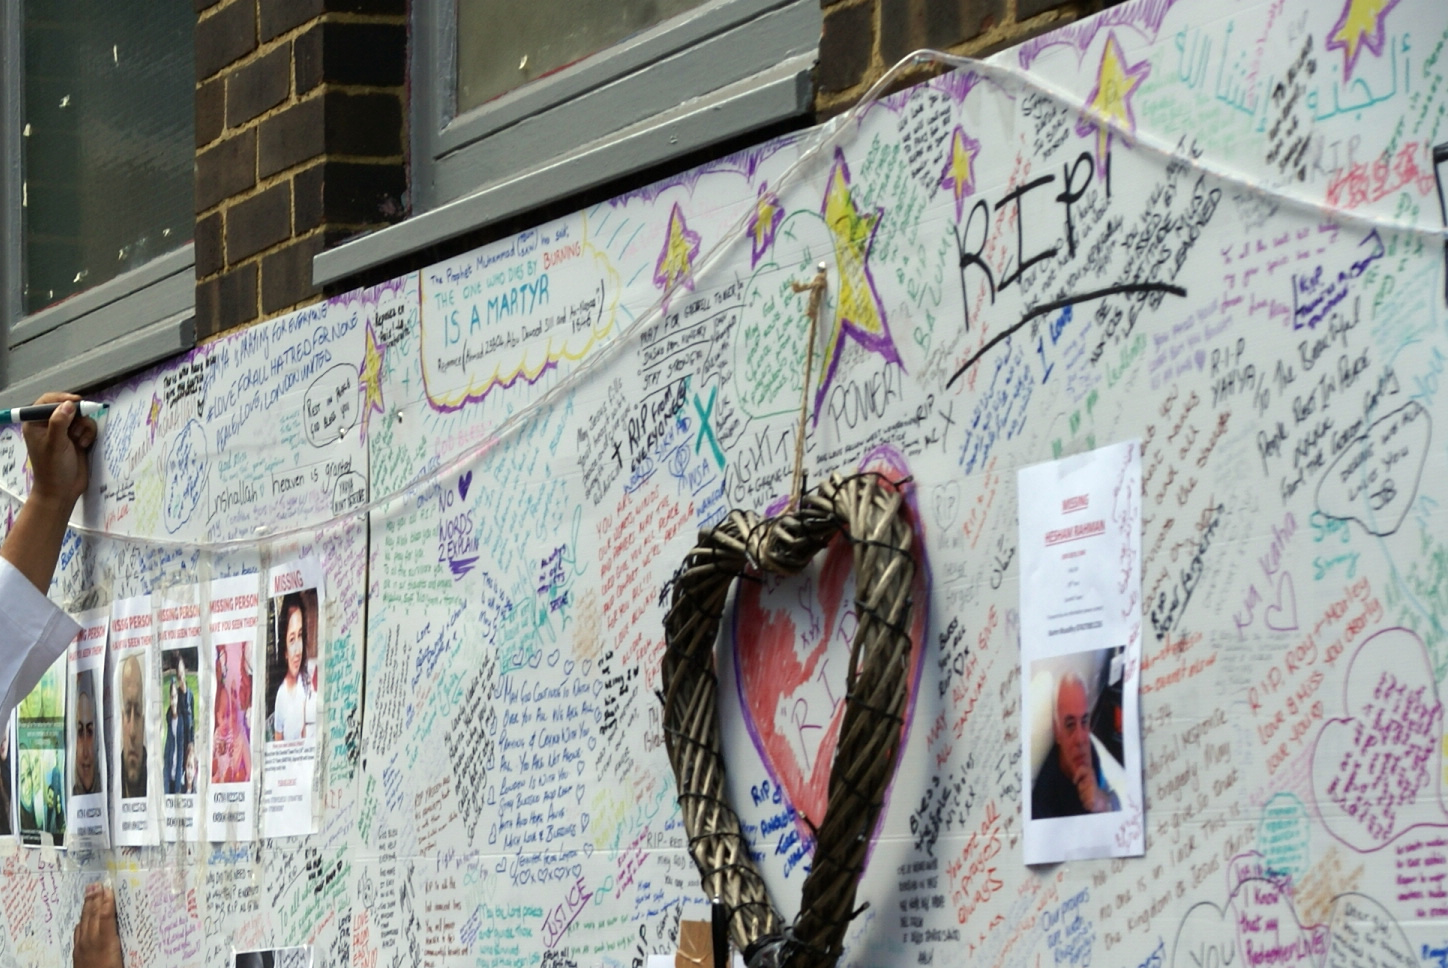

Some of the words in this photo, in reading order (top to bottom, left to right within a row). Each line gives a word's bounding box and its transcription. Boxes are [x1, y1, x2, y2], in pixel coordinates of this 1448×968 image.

[526, 259, 538, 277] BY
[543, 240, 582, 270] BURNING
[444, 309, 462, 348] IS
[470, 304, 482, 336] A
[486, 273, 551, 326] MARTYR
[274, 569, 304, 594] MISSING
